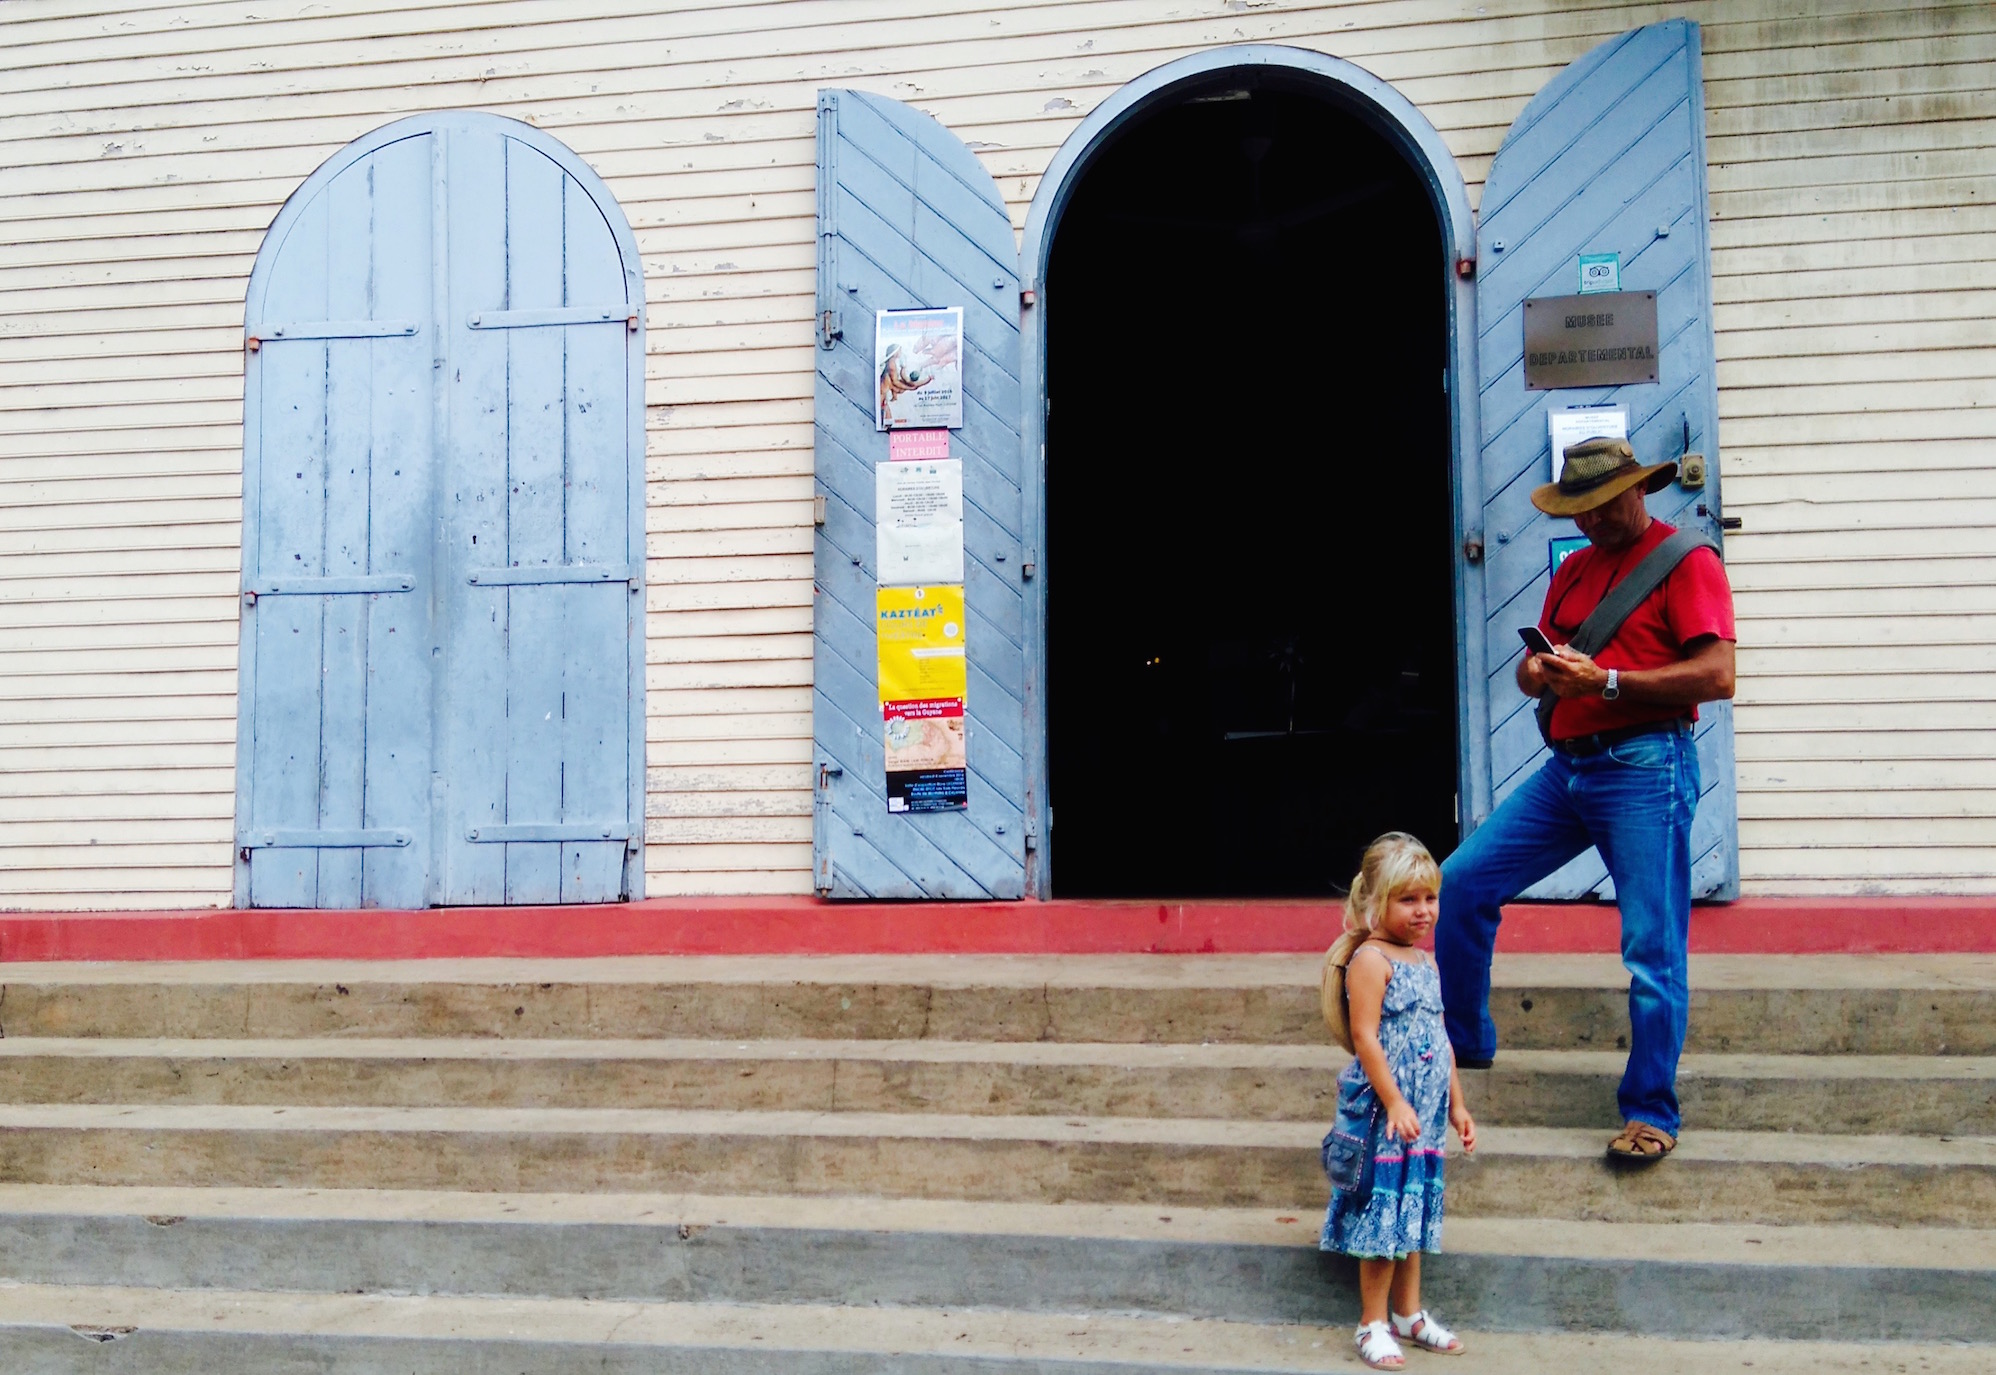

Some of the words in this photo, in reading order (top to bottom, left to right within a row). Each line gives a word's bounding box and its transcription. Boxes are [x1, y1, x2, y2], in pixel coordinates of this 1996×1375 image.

[1565, 313, 1614, 328] MUSEE
[1529, 346, 1654, 366] DEPARTEMENTAL
[893, 431, 945, 443] PORTABLE
[896, 445, 942, 457] INTERDIT
[896, 702, 918, 711] question
[929, 701, 958, 710] migrations
[922, 709, 942, 717] Guyane
